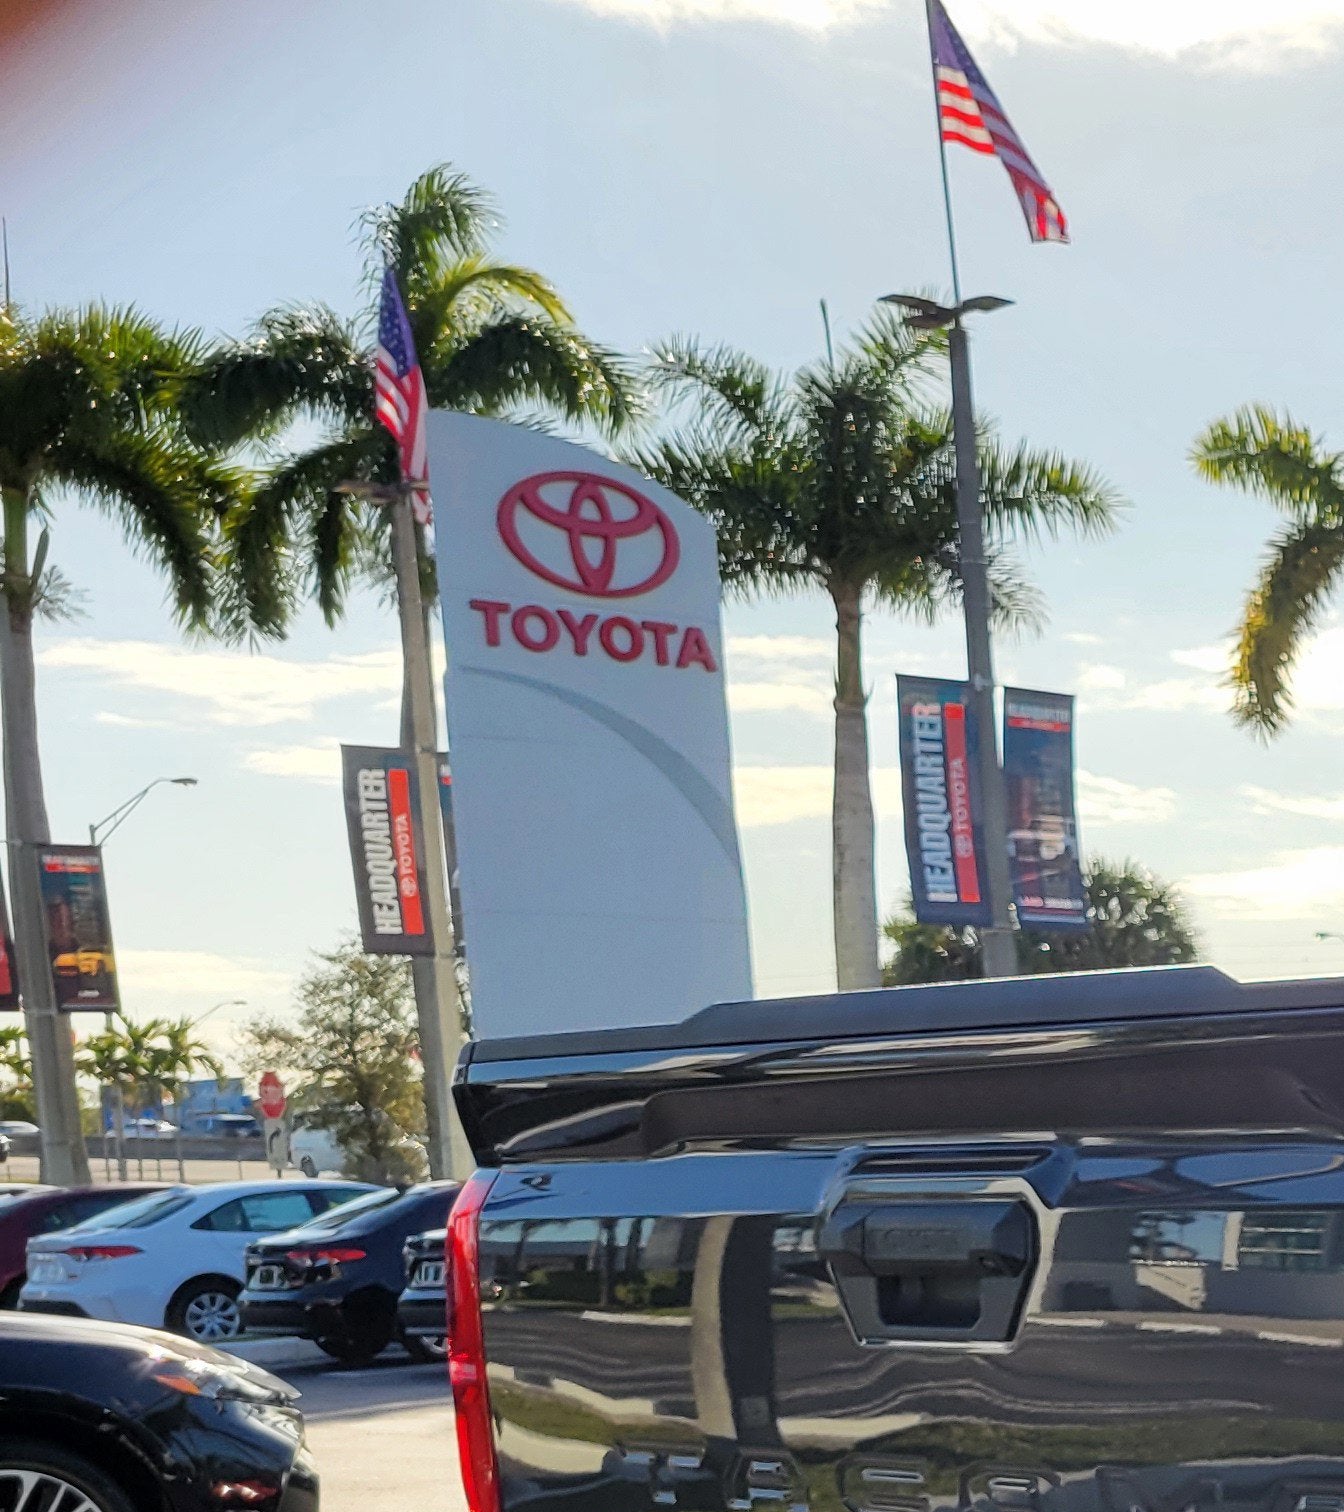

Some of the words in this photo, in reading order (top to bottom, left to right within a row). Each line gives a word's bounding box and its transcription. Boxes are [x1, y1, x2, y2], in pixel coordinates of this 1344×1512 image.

[469, 599, 719, 673] TOYOTA
[911, 702, 958, 902] HEADQUARTER
[950, 757, 973, 831] TOYOTA
[357, 768, 404, 935] HEADQUARTER
[394, 814, 413, 875] TOYOTA
